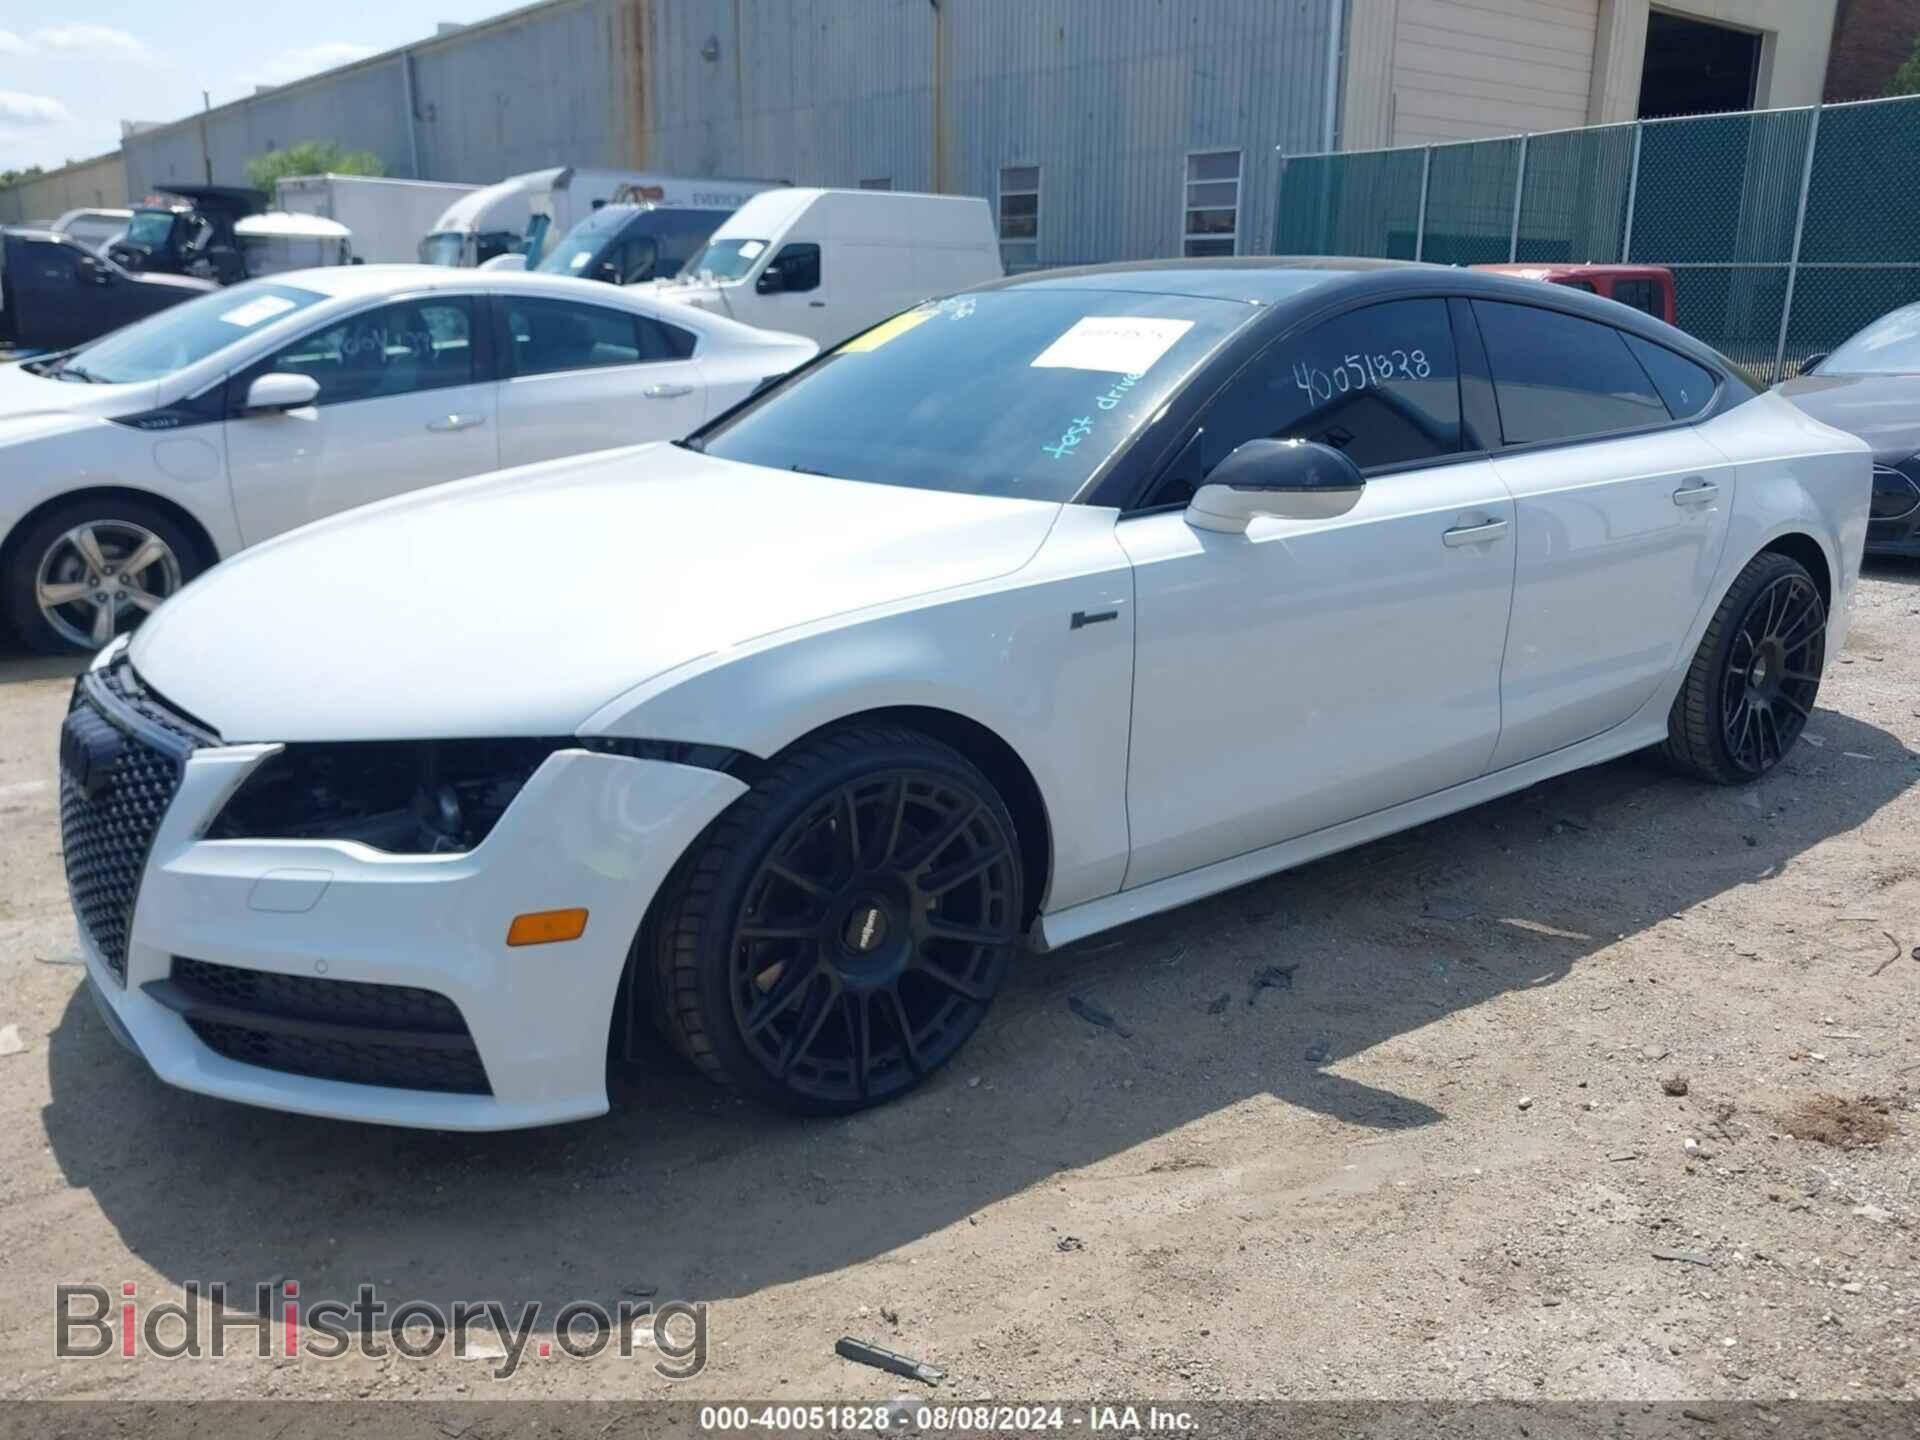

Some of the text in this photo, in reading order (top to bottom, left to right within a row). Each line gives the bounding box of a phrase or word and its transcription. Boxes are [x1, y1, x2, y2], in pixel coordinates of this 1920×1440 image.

[1041, 371, 1145, 459] test drive
[1292, 349, 1431, 408] 40051828
